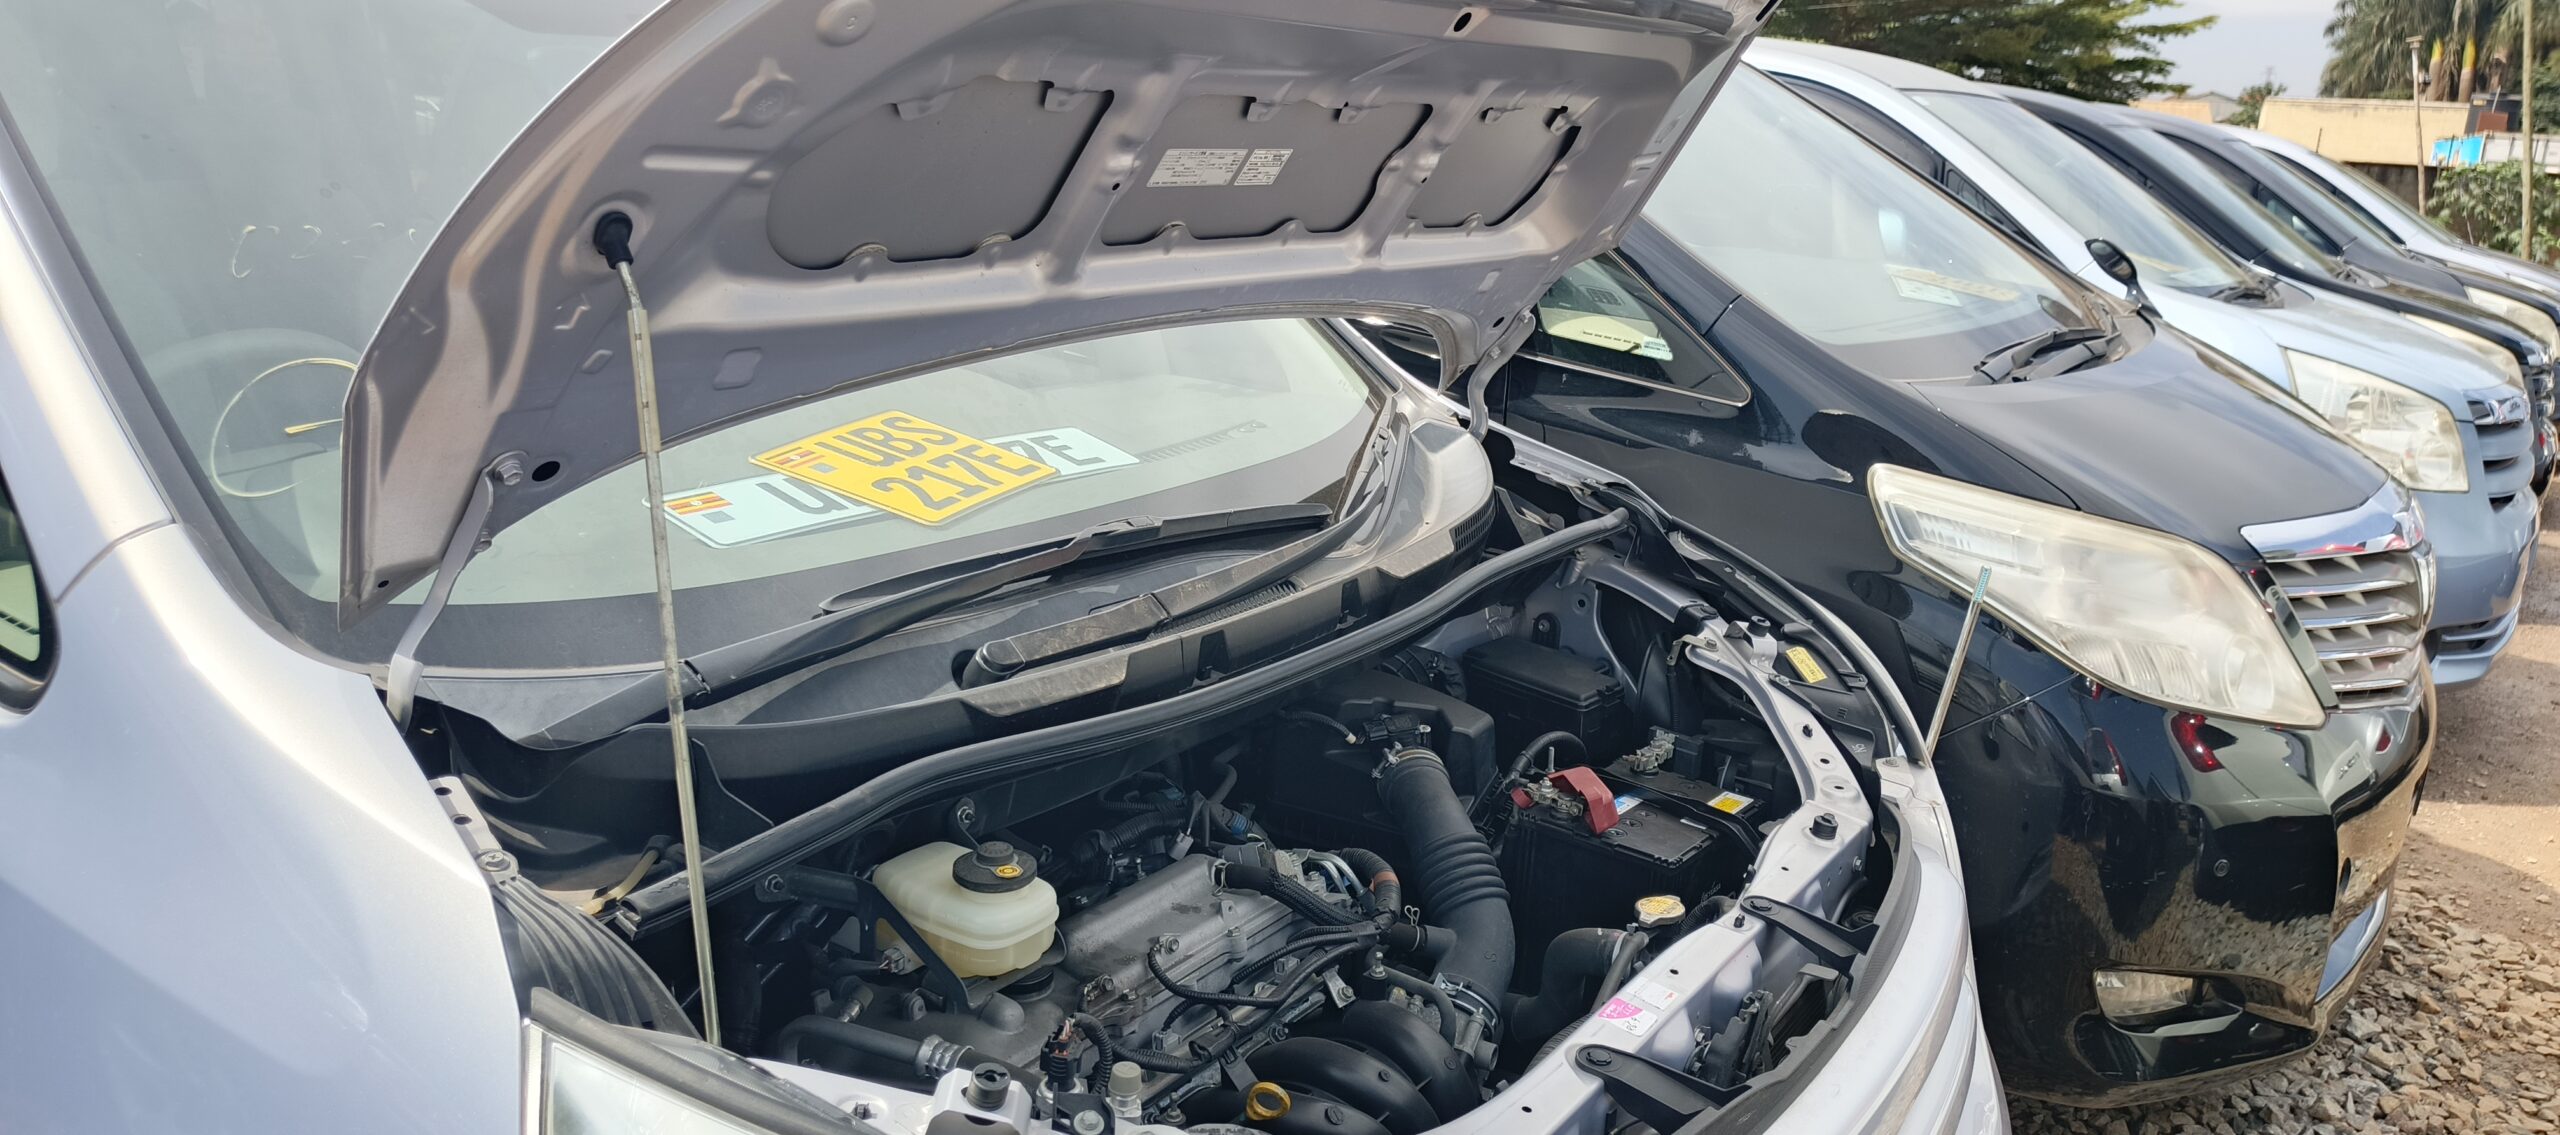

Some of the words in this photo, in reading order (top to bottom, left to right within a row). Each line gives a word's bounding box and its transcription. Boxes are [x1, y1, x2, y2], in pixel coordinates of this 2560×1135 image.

[814, 416, 959, 468] UBS
[755, 478, 866, 515] U
[871, 444, 1035, 511] 217E
